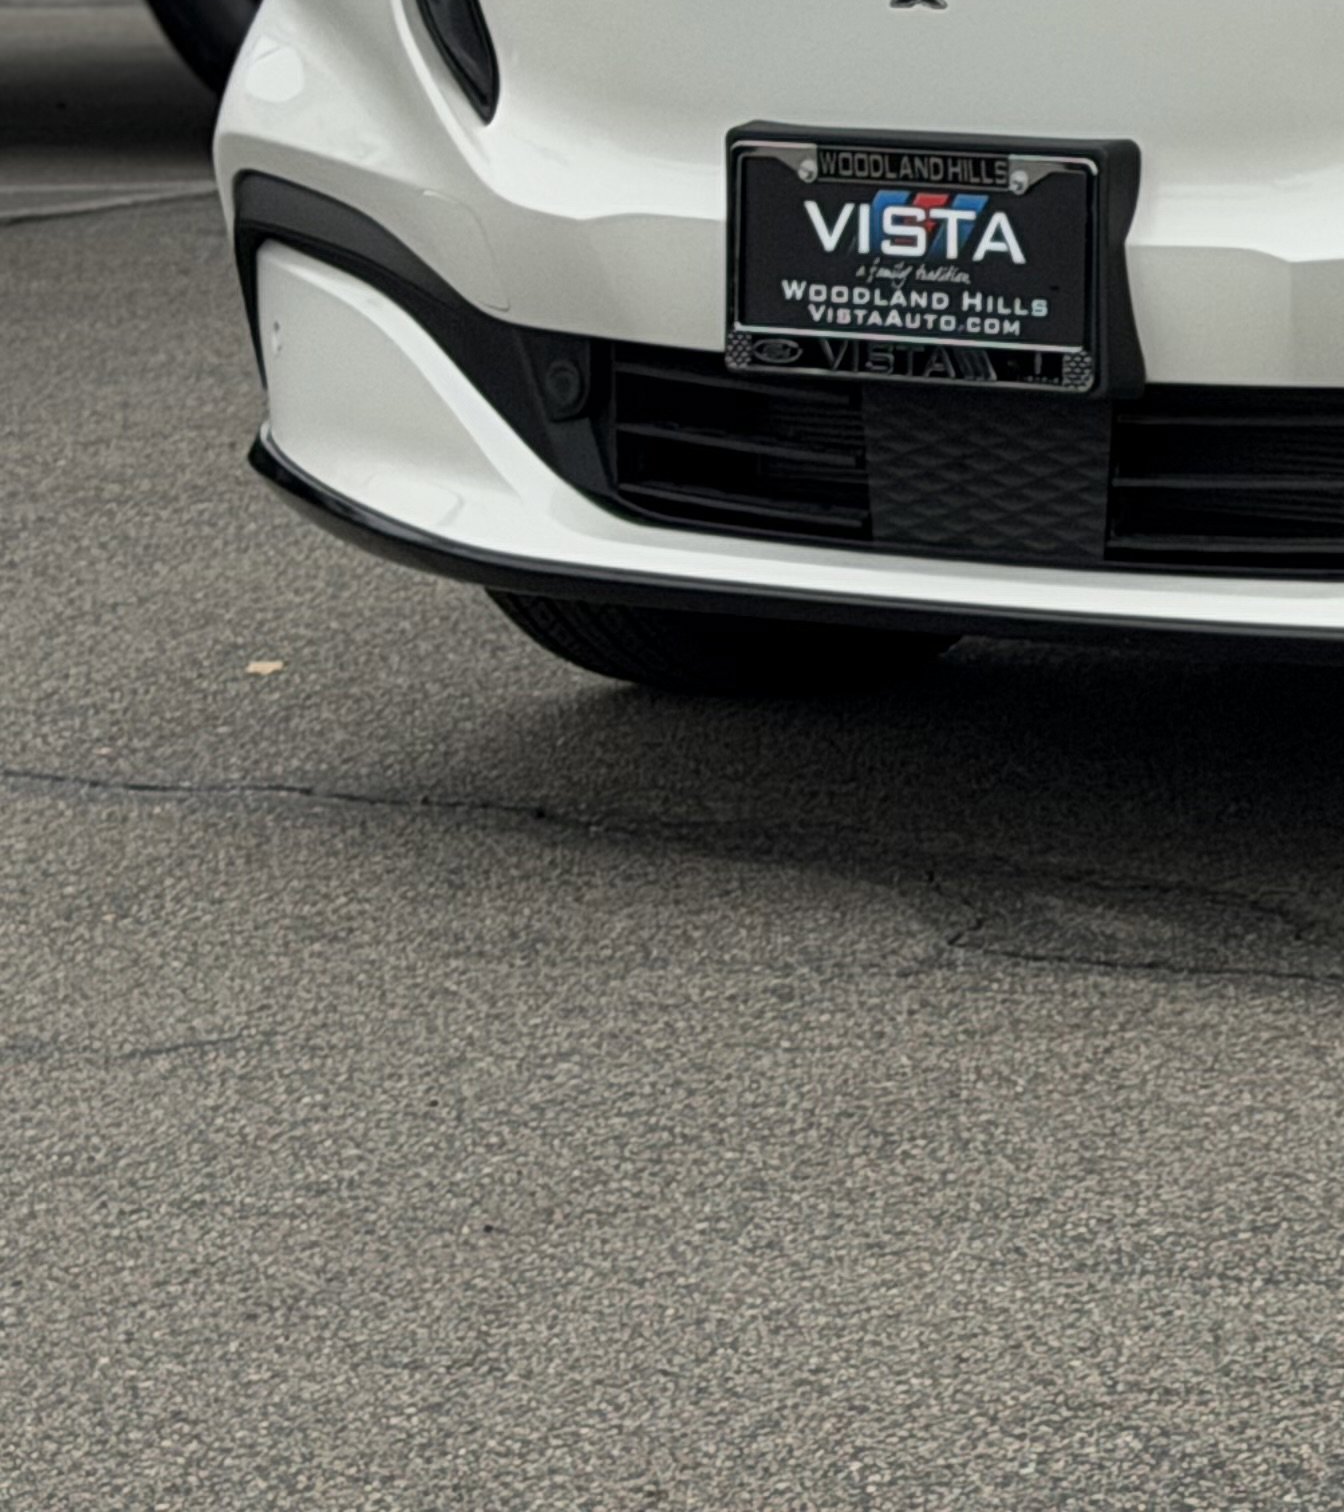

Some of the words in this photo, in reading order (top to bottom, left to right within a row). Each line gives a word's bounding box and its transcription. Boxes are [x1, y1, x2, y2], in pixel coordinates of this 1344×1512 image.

[818, 151, 945, 181] WOODLAND
[948, 157, 1007, 185] HILLS
[804, 199, 1027, 265] VISTA
[866, 257, 914, 288] family
[915, 263, 972, 286] tradition
[781, 279, 950, 311] WOODLAND
[961, 290, 1048, 317] HILLS
[819, 337, 957, 379] VISTA
